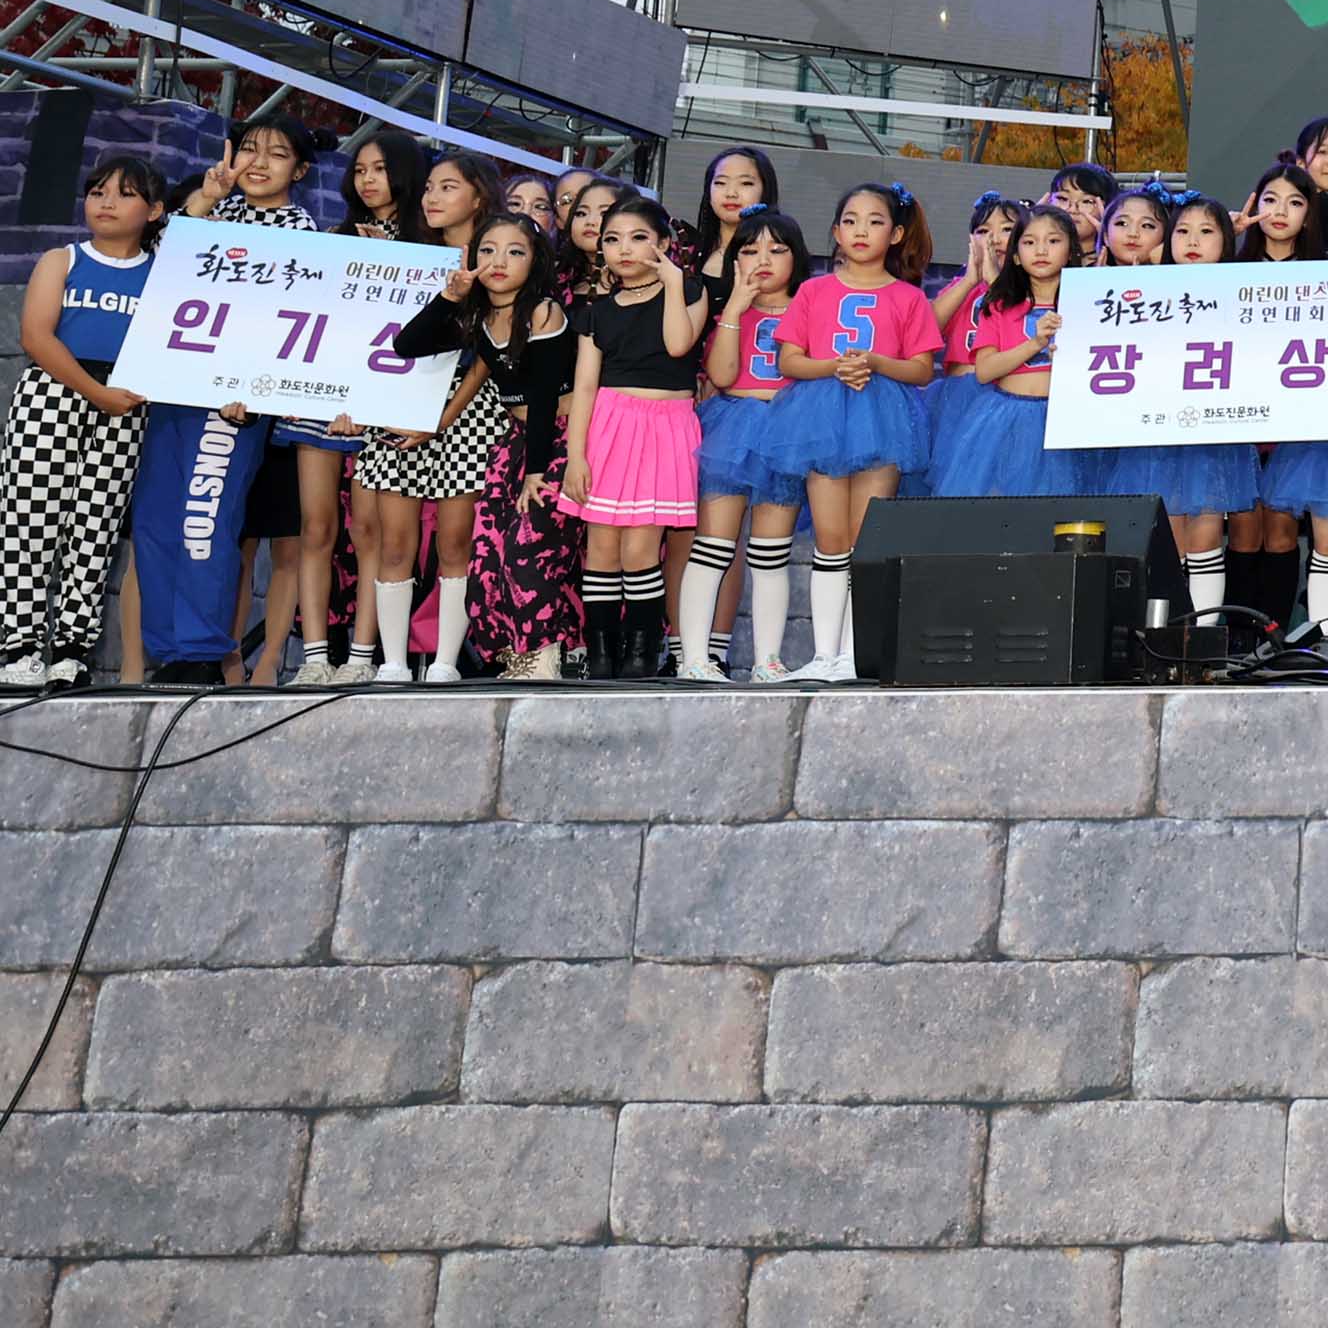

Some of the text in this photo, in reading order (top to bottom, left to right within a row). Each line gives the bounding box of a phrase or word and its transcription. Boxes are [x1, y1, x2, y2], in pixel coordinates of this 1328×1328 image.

[195, 244, 322, 291] 화도진 축제
[346, 261, 438, 286] 어린이 댄스
[1238, 283, 1328, 303] 어린이 댄스
[1094, 289, 1217, 326] 화도진 축제
[1238, 304, 1324, 324] 경연대회
[279, 378, 350, 398] 화도진문화원
[1203, 405, 1270, 419] 화도진문화원
[183, 410, 239, 560] NONSTOP
